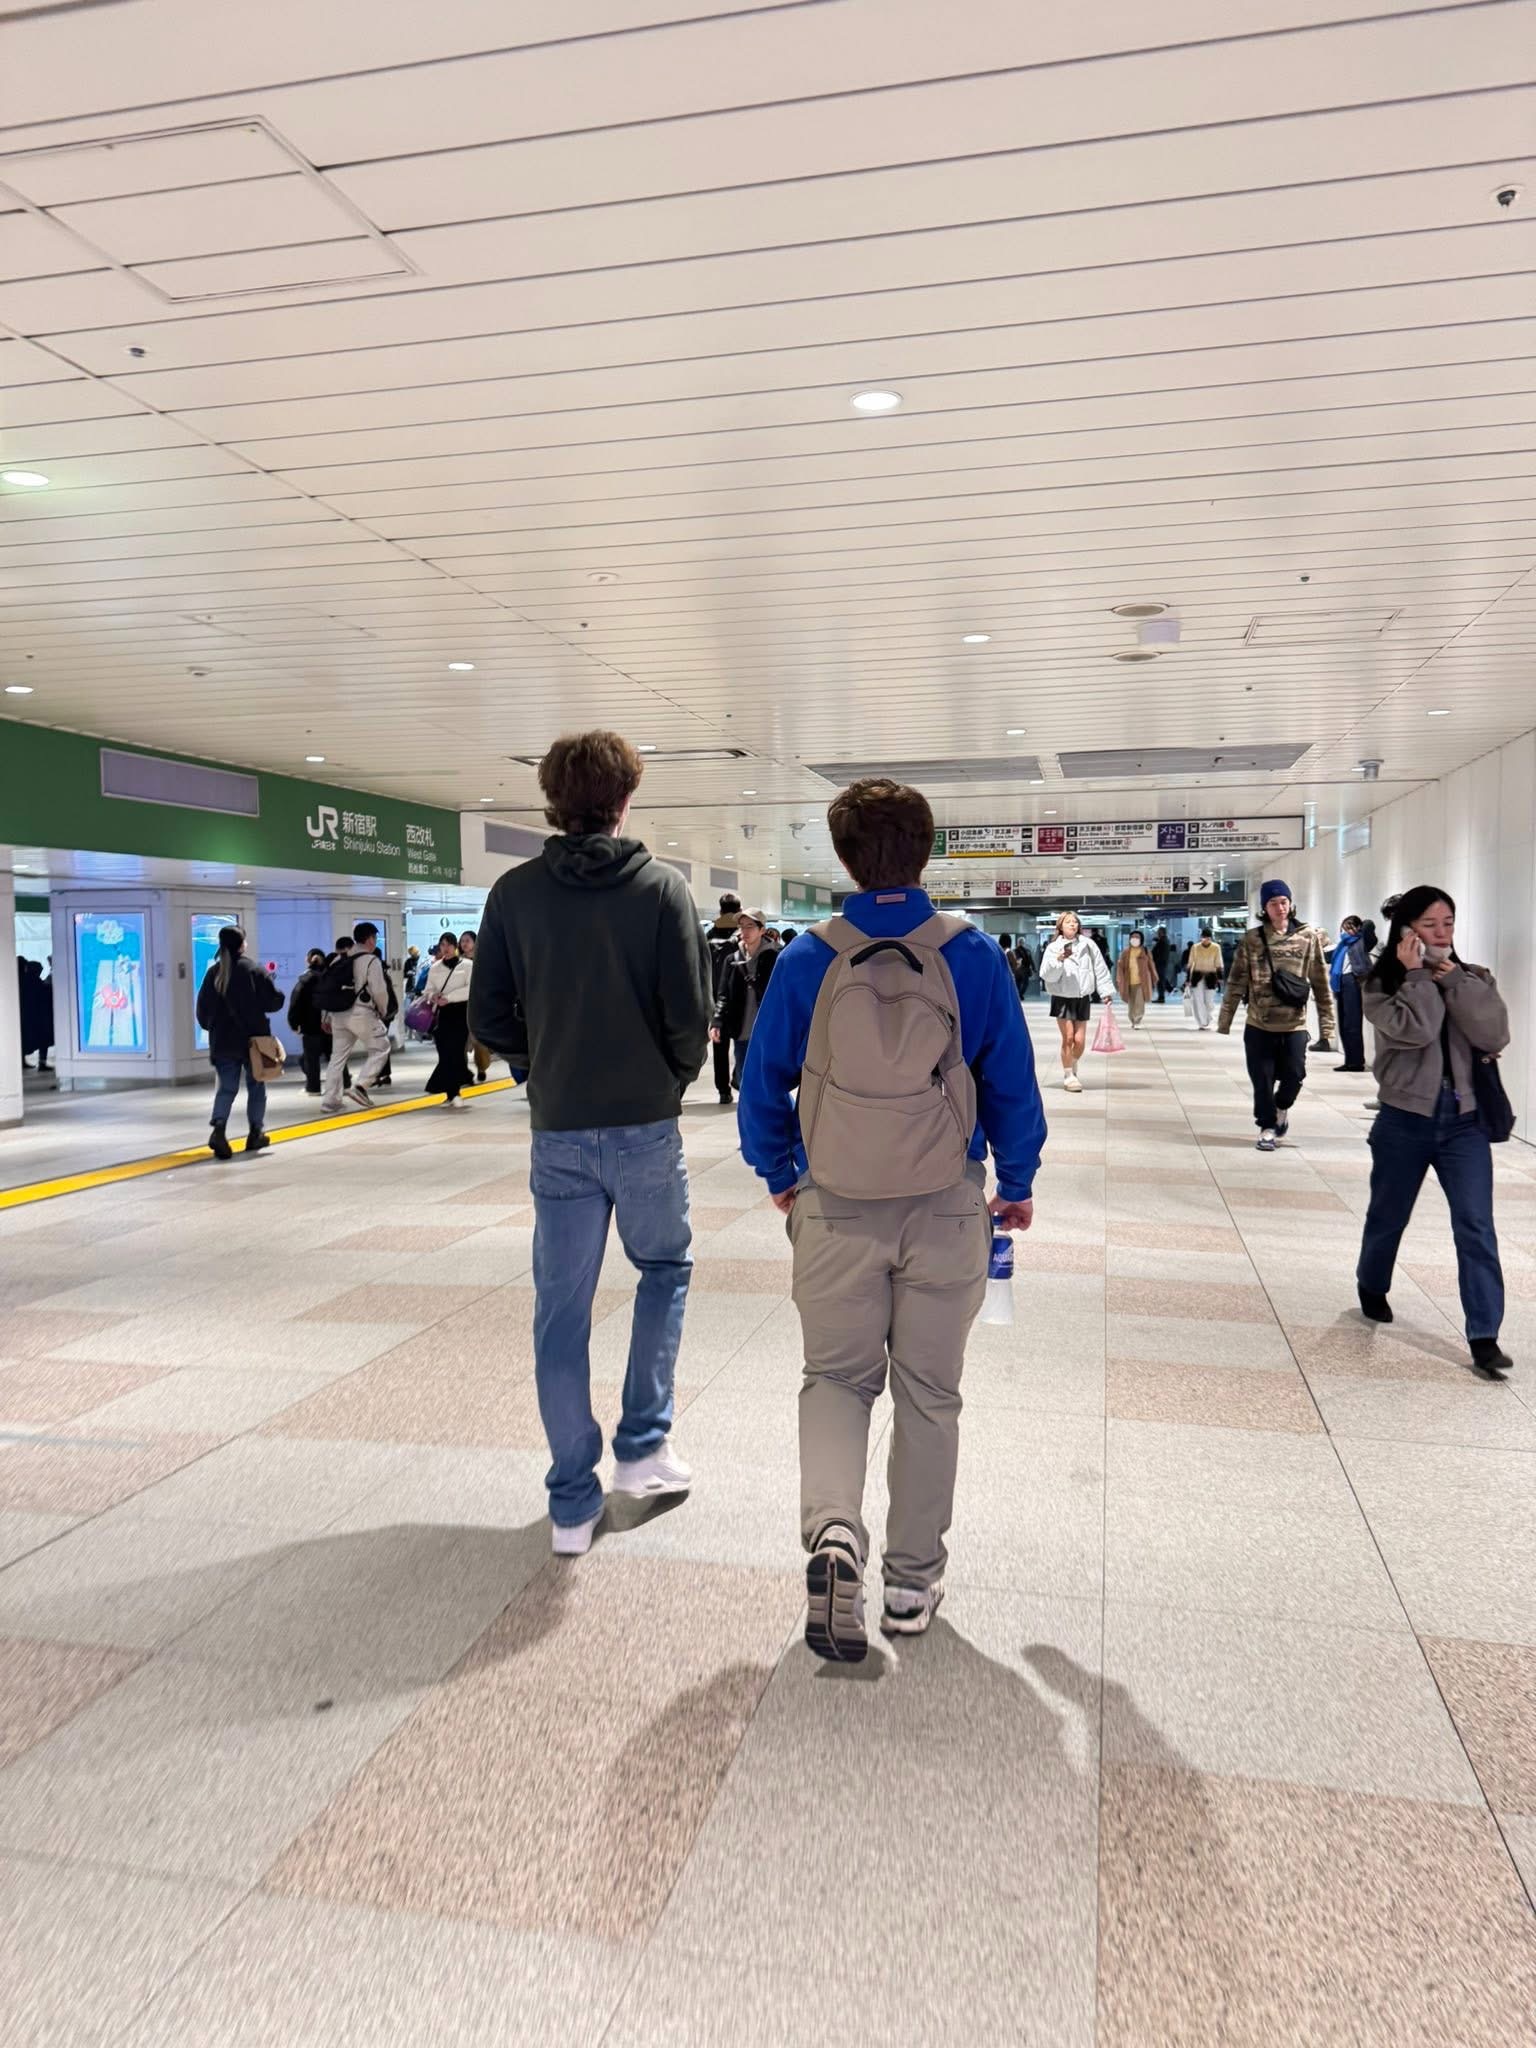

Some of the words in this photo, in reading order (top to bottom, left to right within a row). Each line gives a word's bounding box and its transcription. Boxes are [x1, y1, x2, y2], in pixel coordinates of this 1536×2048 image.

[306, 805, 339, 840] JR
[342, 811, 377, 837] 新宿駅
[1160, 825, 1184, 834] メトロ
[343, 836, 375, 854] Shinjuku
[376, 841, 401, 856] Station
[406, 824, 435, 847] 西改札
